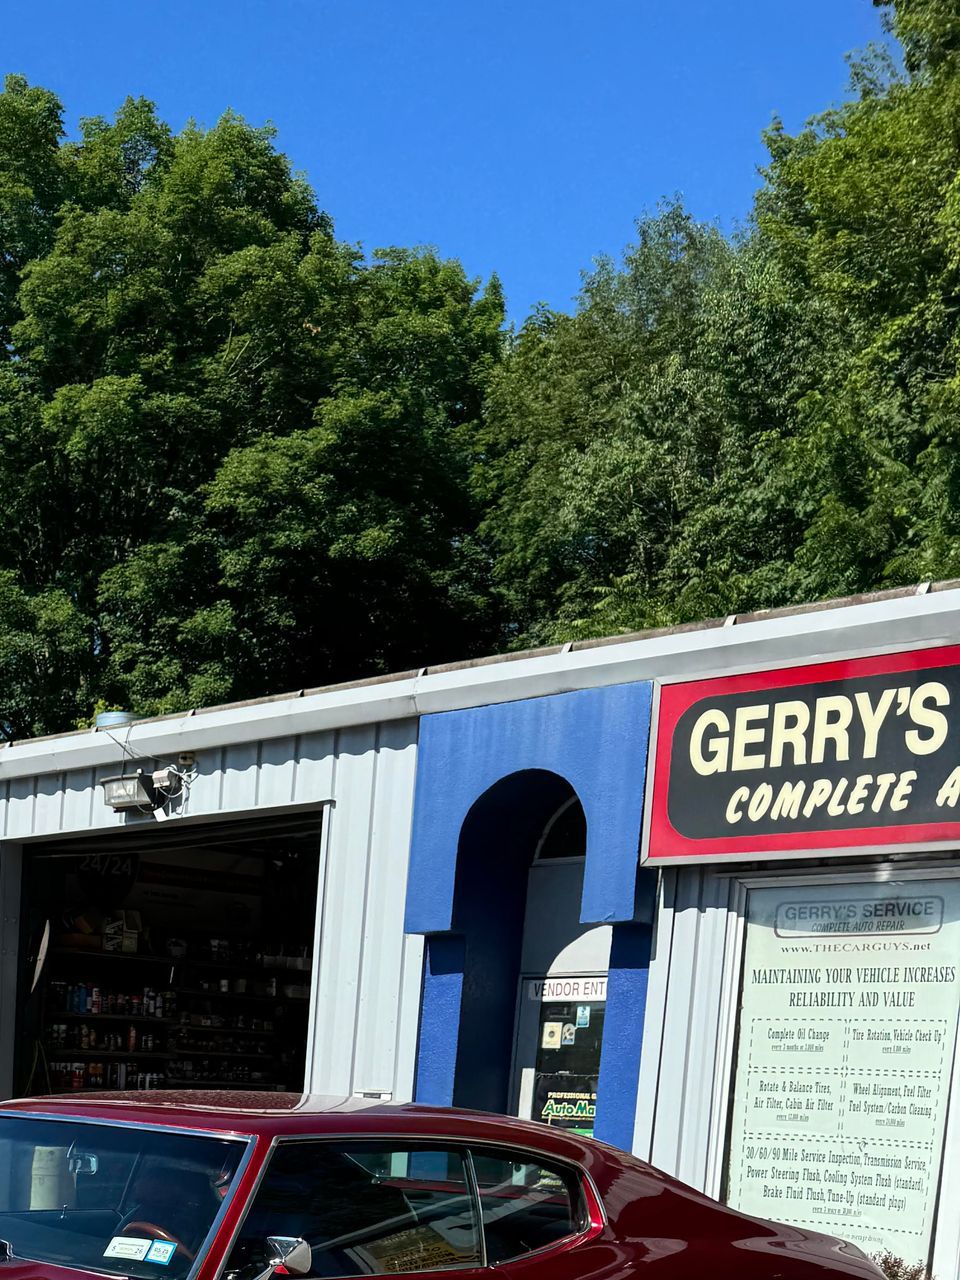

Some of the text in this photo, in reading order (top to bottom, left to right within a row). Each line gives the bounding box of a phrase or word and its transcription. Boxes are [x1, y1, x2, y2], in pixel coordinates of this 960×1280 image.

[689, 681, 951, 777] GERRY'S
[725, 766, 960, 825] COMPLETE A
[785, 901, 935, 921] GERRY'S SERVICE
[811, 919, 905, 933] COMPLETE AUTO REPAIR
[781, 941, 931, 953] www.THECARGUYS.net
[751, 966, 956, 984] MAINTAINING YOUR VEHICLE INCREASES
[534, 981, 606, 997] VENDOR ENT
[789, 991, 916, 1007] RELIABILITY AND VALUE
[768, 1028, 830, 1042] Complete Oil Change
[852, 1028, 864, 1041] Tire
[893, 1028, 913, 1041] Vehicle
[915, 1029, 932, 1042] Check
[934, 1029, 942, 1044] Up
[759, 1080, 832, 1095] Rotate & Balance Tires,
[853, 1082, 870, 1095] Wheel
[903, 1084, 916, 1097] Fuel
[917, 1085, 932, 1098] Filter
[541, 1099, 575, 1116] Auto
[753, 1096, 834, 1111] Air Filter, Cabin Air Filter
[848, 1100, 862, 1112] Fuel
[909, 1103, 932, 1118] Cleaning
[746, 1146, 781, 1160] 30/60/90
[782, 1147, 798, 1161] Mile
[801, 1148, 826, 1162] Service
[828, 1150, 862, 1167] Inspection,
[864, 1152, 902, 1168] Transmission
[746, 1165, 769, 1179] Power
[771, 1166, 800, 1183] Steering
[823, 1169, 848, 1186] Cooling
[850, 1171, 873, 1187] System
[875, 1173, 892, 1188] Flush
[763, 1184, 783, 1198] Brake
[785, 1186, 804, 1200] Fluid
[828, 1188, 855, 1206] Tune-Up
[857, 1191, 887, 1207] (standard
